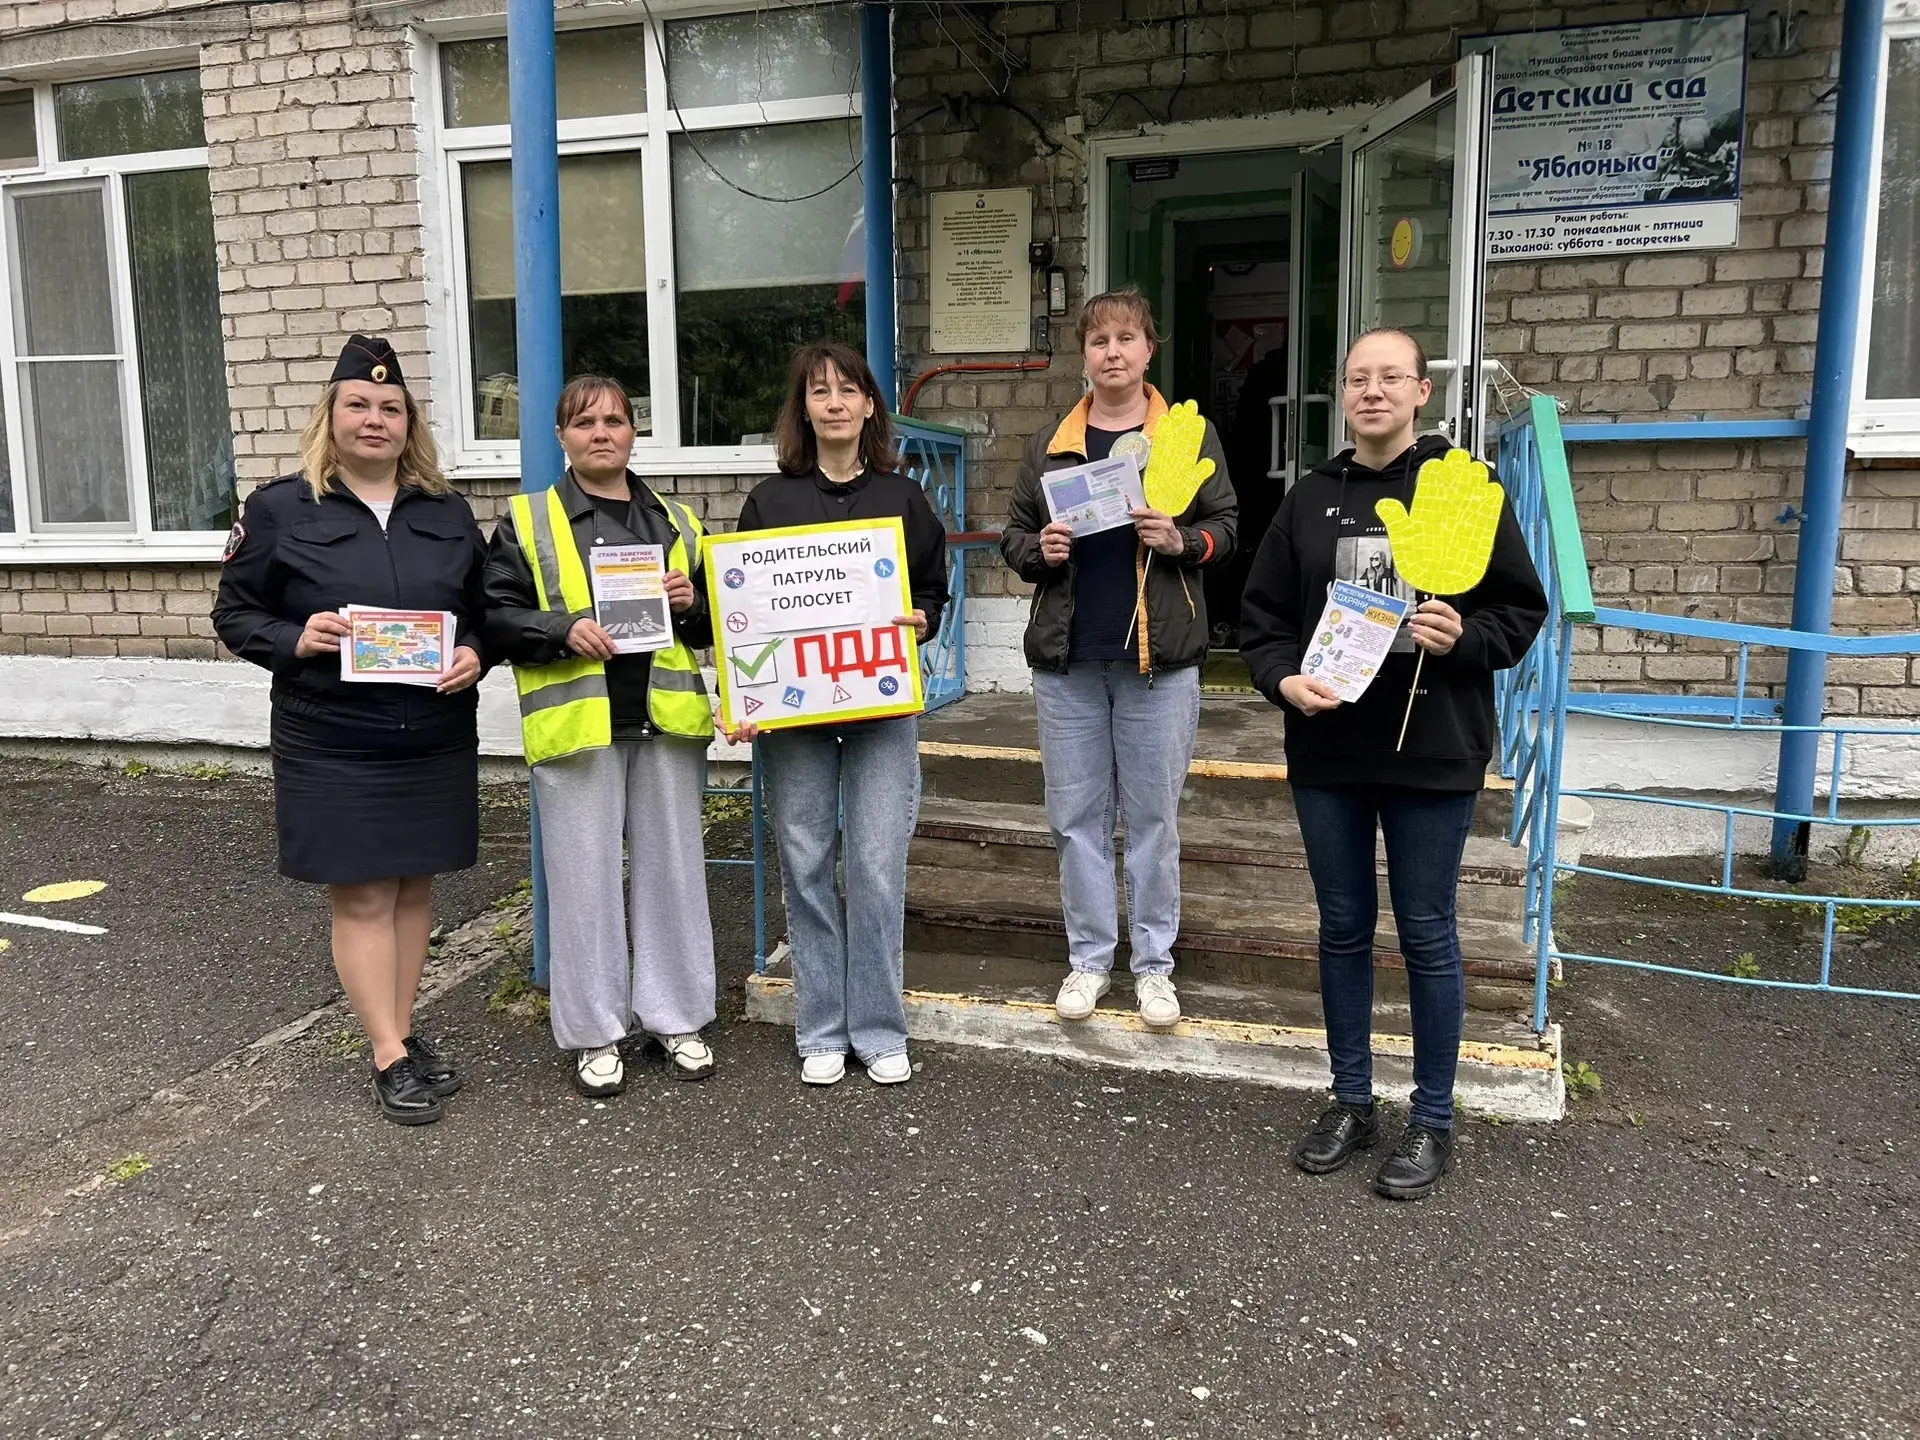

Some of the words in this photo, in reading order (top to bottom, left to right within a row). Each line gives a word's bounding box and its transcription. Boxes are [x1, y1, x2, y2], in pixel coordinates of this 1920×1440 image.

[1528, 52, 1608, 67] Муниципальное
[1612, 46, 1674, 58] бюджетное
[1495, 68, 1550, 80] ошкольное
[1555, 60, 1644, 76] образовательное
[1649, 55, 1712, 69] учреждение
[1492, 77, 1633, 114] Детский
[1647, 77, 1707, 101] сад
[1578, 141, 1593, 153] №
[1598, 139, 1612, 151] 18
[1517, 149, 1675, 182] "Яблонька"
[1489, 192, 1520, 200] раслевой
[1555, 215, 1587, 223] Режим
[1590, 211, 1629, 222] работы:
[1487, 230, 1514, 241] 7.30
[1525, 227, 1556, 239] 17.30
[1563, 223, 1641, 236] понедельник
[1653, 220, 1703, 231] пятница
[1491, 242, 1553, 254] Выходной:
[1557, 238, 1604, 251] суббота
[1616, 234, 1691, 247] воскресенье
[741, 537, 871, 566] РОДИТЕЛЬСКИЙ
[772, 568, 846, 587] ПАТРУЛЬ
[771, 591, 853, 611] ГОЛОСУЕТ
[1332, 591, 1368, 609] СОХРАНИ
[1365, 608, 1397, 625] ЖИЗНЬ
[793, 626, 908, 683] ПДД
